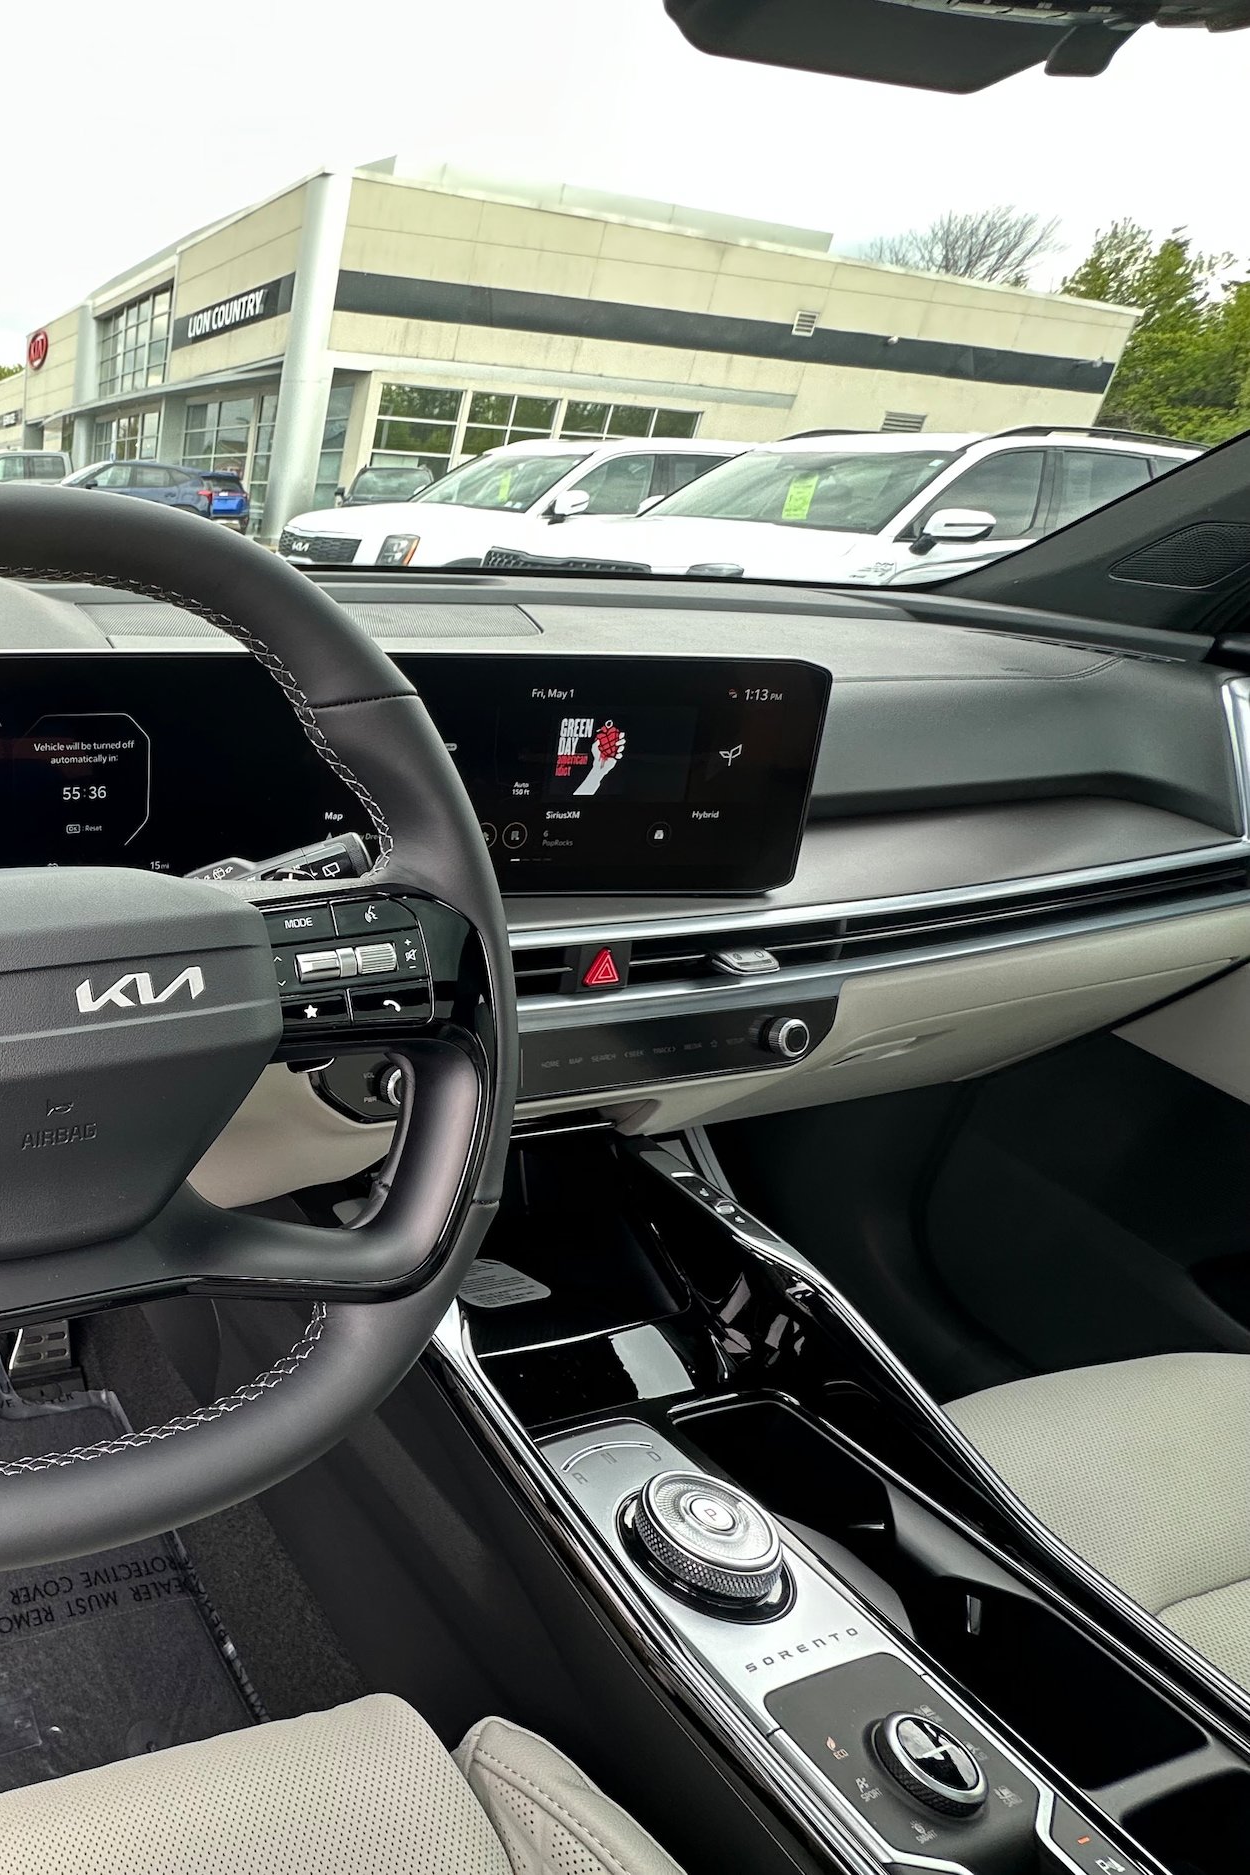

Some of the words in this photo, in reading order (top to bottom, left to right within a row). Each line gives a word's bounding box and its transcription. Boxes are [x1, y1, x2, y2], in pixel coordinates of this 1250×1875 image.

[188, 309, 211, 337] LION
[212, 289, 264, 330] COUNTRY
[531, 688, 546, 699] Fri,
[547, 688, 568, 700] May
[570, 688, 575, 698] 1
[744, 688, 769, 701] 1:13
[770, 693, 783, 701] PM
[560, 718, 594, 738] GREEN
[33, 742, 65, 752] Vehicle
[66, 742, 80, 751] will
[81, 742, 92, 750] be
[93, 741, 121, 750] turned
[122, 740, 135, 749] off
[558, 737, 579, 755] DAY
[50, 754, 107, 764] automatically
[557, 755, 588, 765] american
[324, 811, 344, 822] Map
[546, 811, 581, 819] SiriusXM
[692, 810, 719, 820] Hybrid
[284, 917, 313, 930] MODE
[75, 966, 205, 1013] KIA
[21, 1123, 98, 1150] AIRBAG
[704, 1508, 718, 1521] P
[10, 1575, 73, 1605] COVER
[67, 1590, 118, 1618] MUST
[745, 1627, 859, 1673] SORENTO
[833, 1748, 849, 1760] ECO
